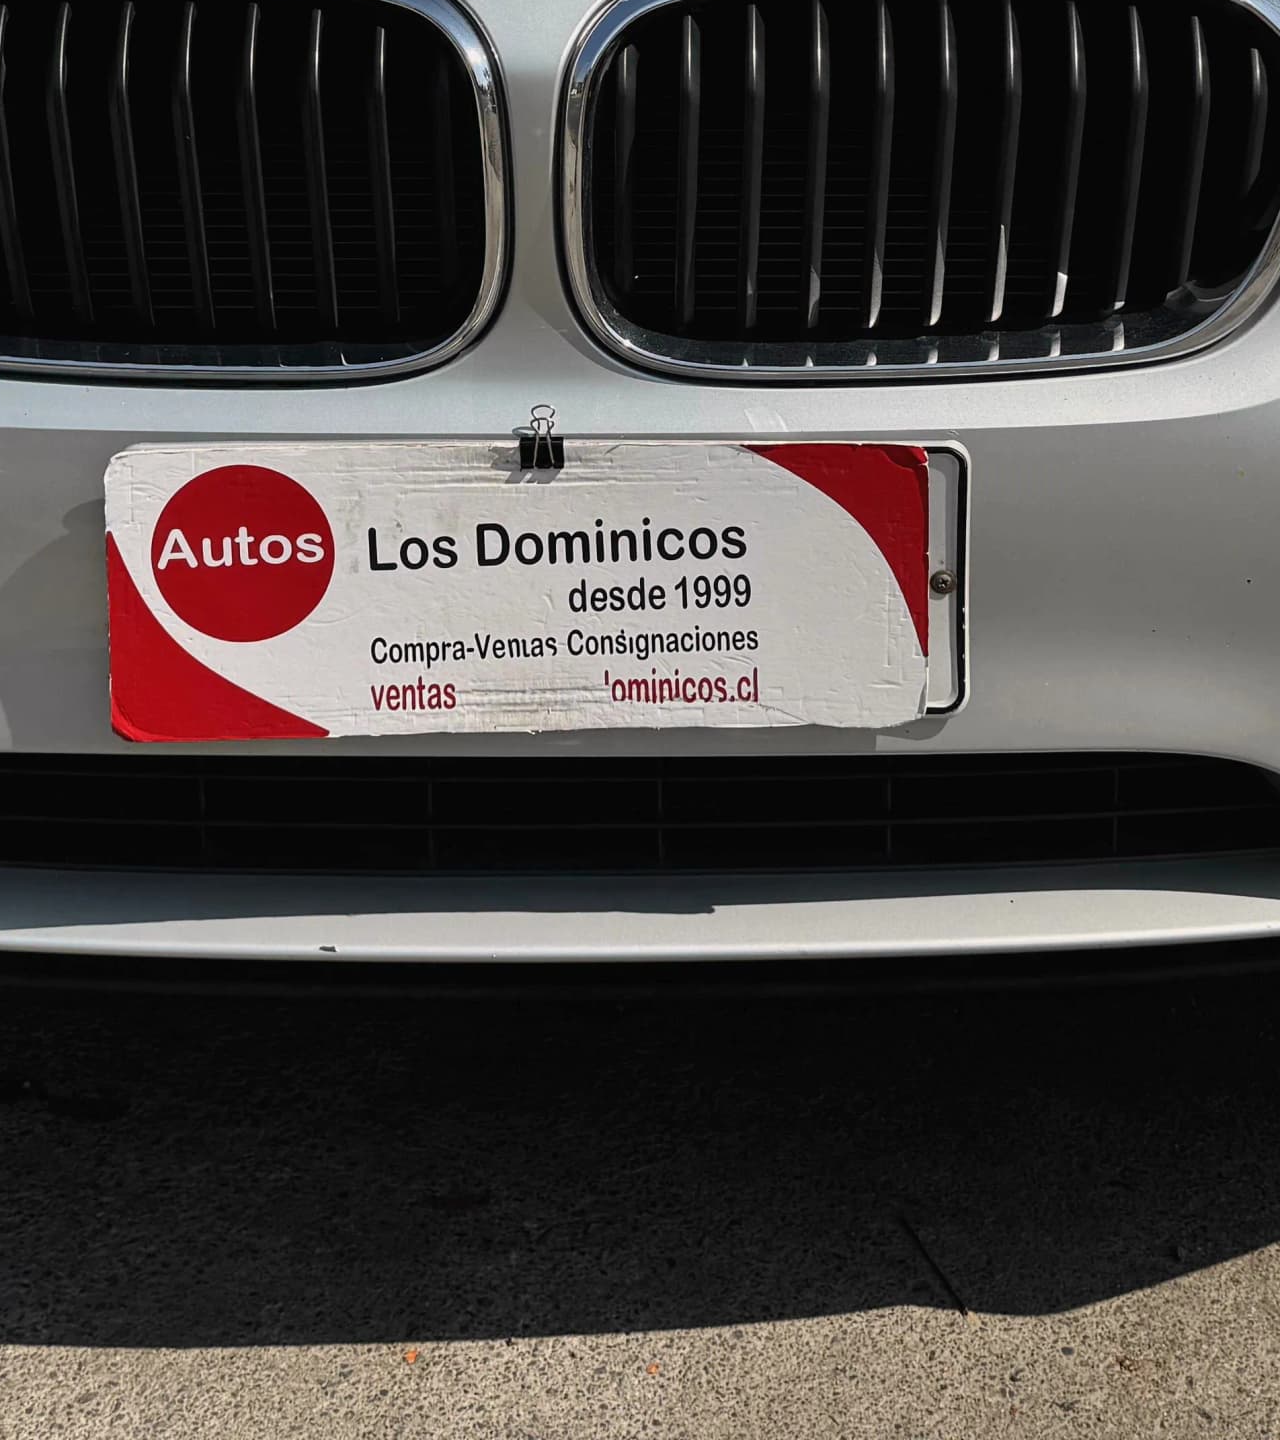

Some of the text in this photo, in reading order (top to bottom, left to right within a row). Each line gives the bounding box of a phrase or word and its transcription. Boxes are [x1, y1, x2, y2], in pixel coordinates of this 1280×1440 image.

[156, 525, 325, 570] Autos
[367, 516, 748, 571] Los Dominicos
[568, 573, 753, 613] desde 1999
[566, 624, 759, 662] Consignaciones
[370, 675, 457, 711] ventas
